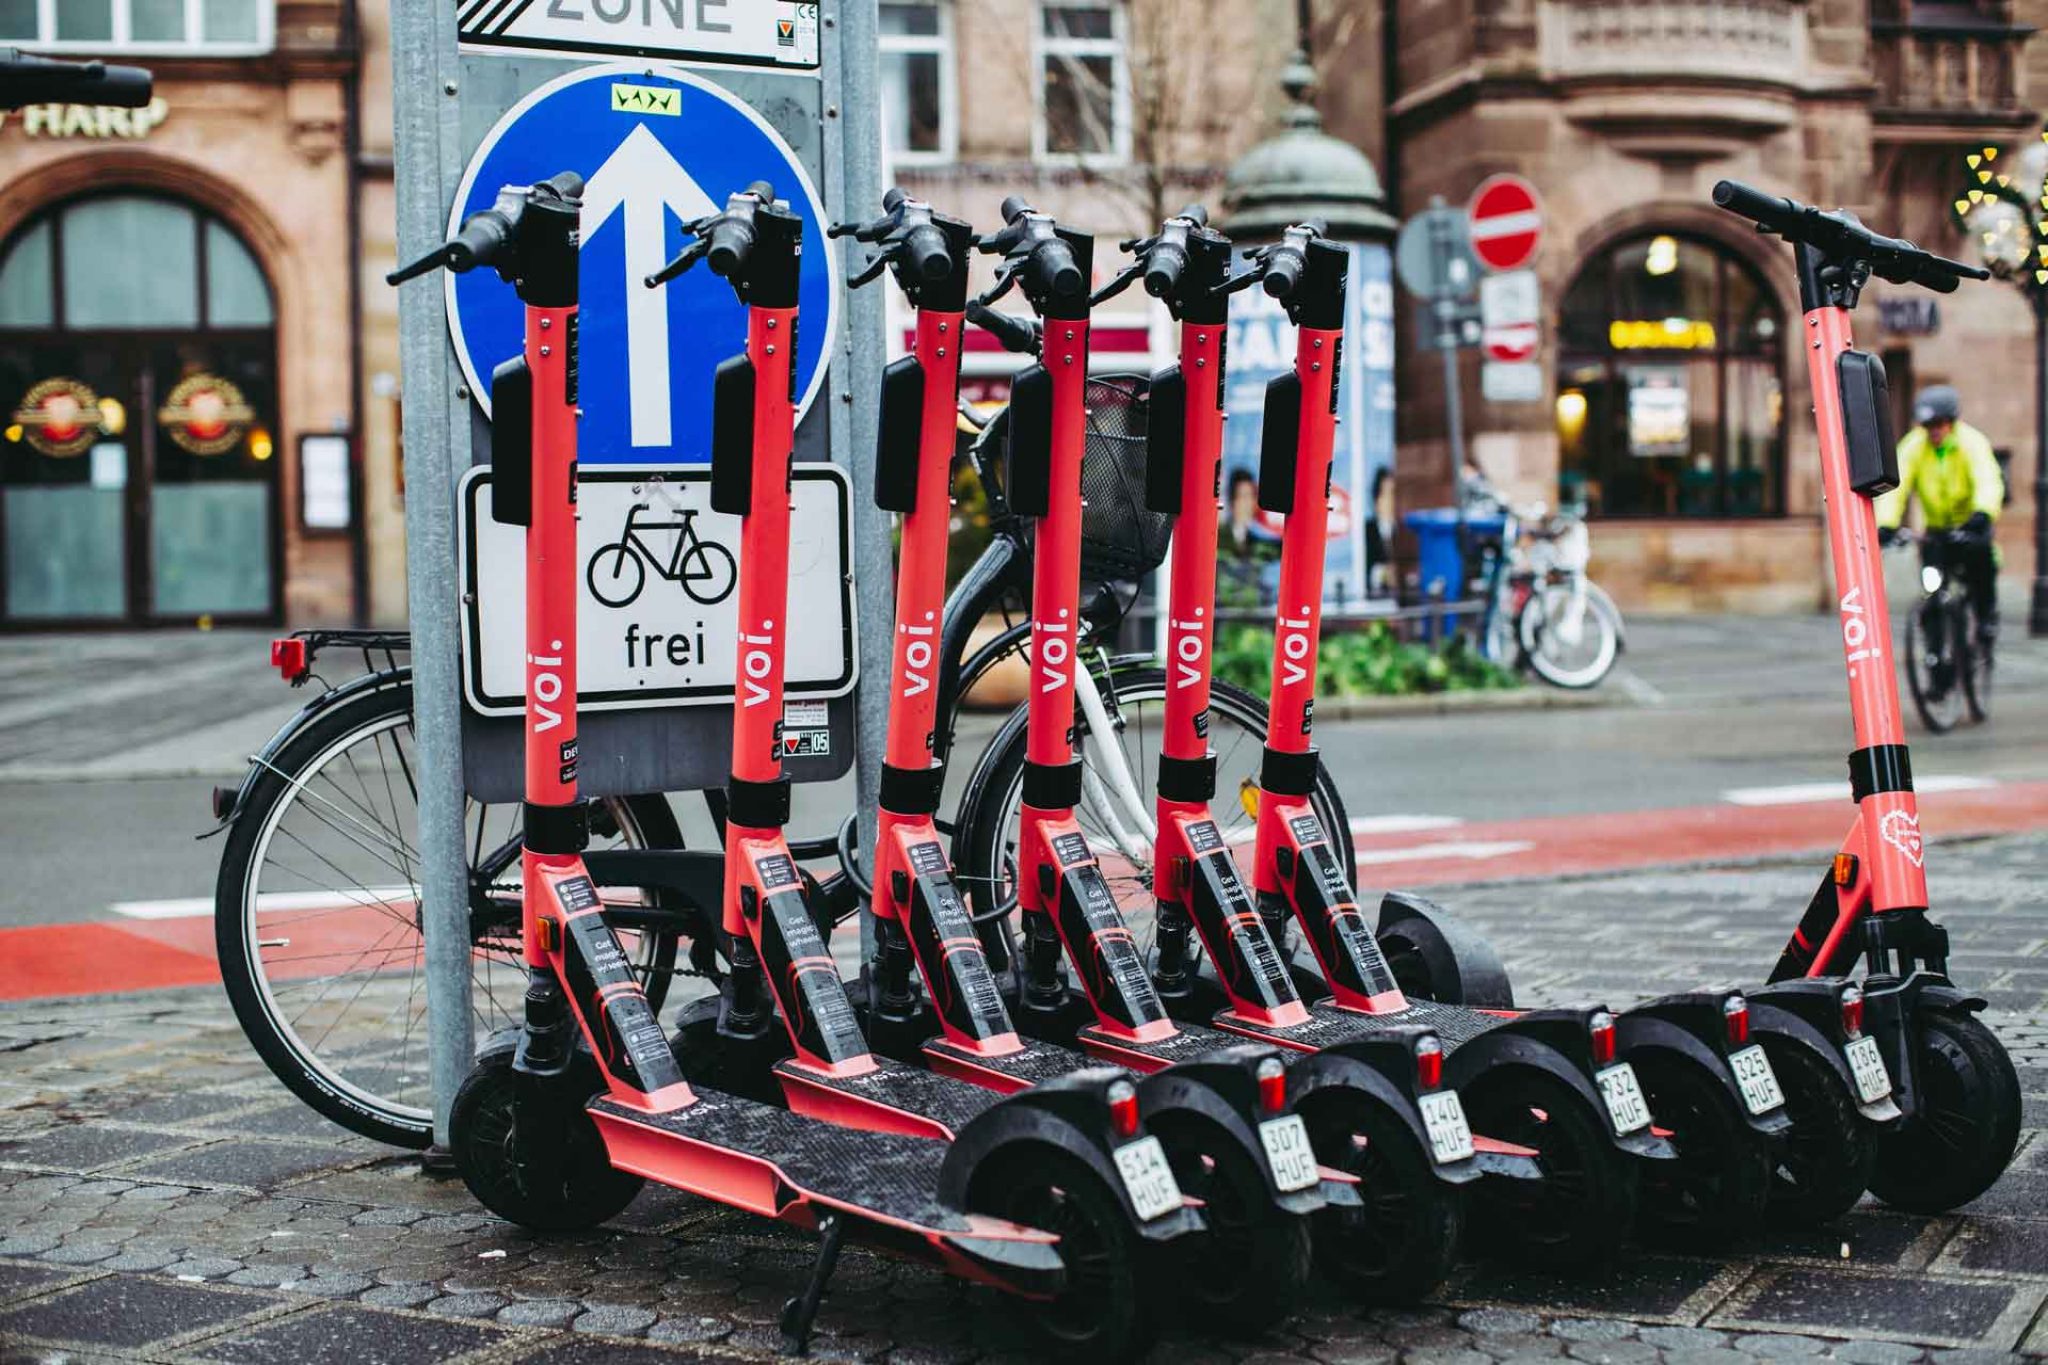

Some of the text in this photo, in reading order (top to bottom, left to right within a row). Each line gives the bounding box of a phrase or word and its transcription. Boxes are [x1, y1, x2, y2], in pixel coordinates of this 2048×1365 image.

[24, 97, 168, 137] HARP
[625, 621, 705, 668] frei
[1171, 607, 1204, 689] voi.
[1279, 606, 1310, 686] voi.
[1841, 587, 1881, 678] voi.
[739, 619, 773, 707] voi.
[900, 610, 934, 697] voi.
[1035, 608, 1068, 693] voi.
[527, 639, 562, 732] voi.
[814, 733, 828, 751] 05
[1735, 1052, 1766, 1081] 325
[1850, 1042, 1877, 1069] 186
[1600, 1071, 1634, 1097] 932
[1743, 1078, 1774, 1106] HUF
[1858, 1069, 1885, 1097] HUF
[1424, 1096, 1458, 1125] 140
[1611, 1097, 1644, 1125] HUF
[1266, 1123, 1300, 1153] 307
[1433, 1125, 1467, 1153] HUF
[1276, 1154, 1311, 1186] HUF
[1135, 1175, 1170, 1208] HUF
